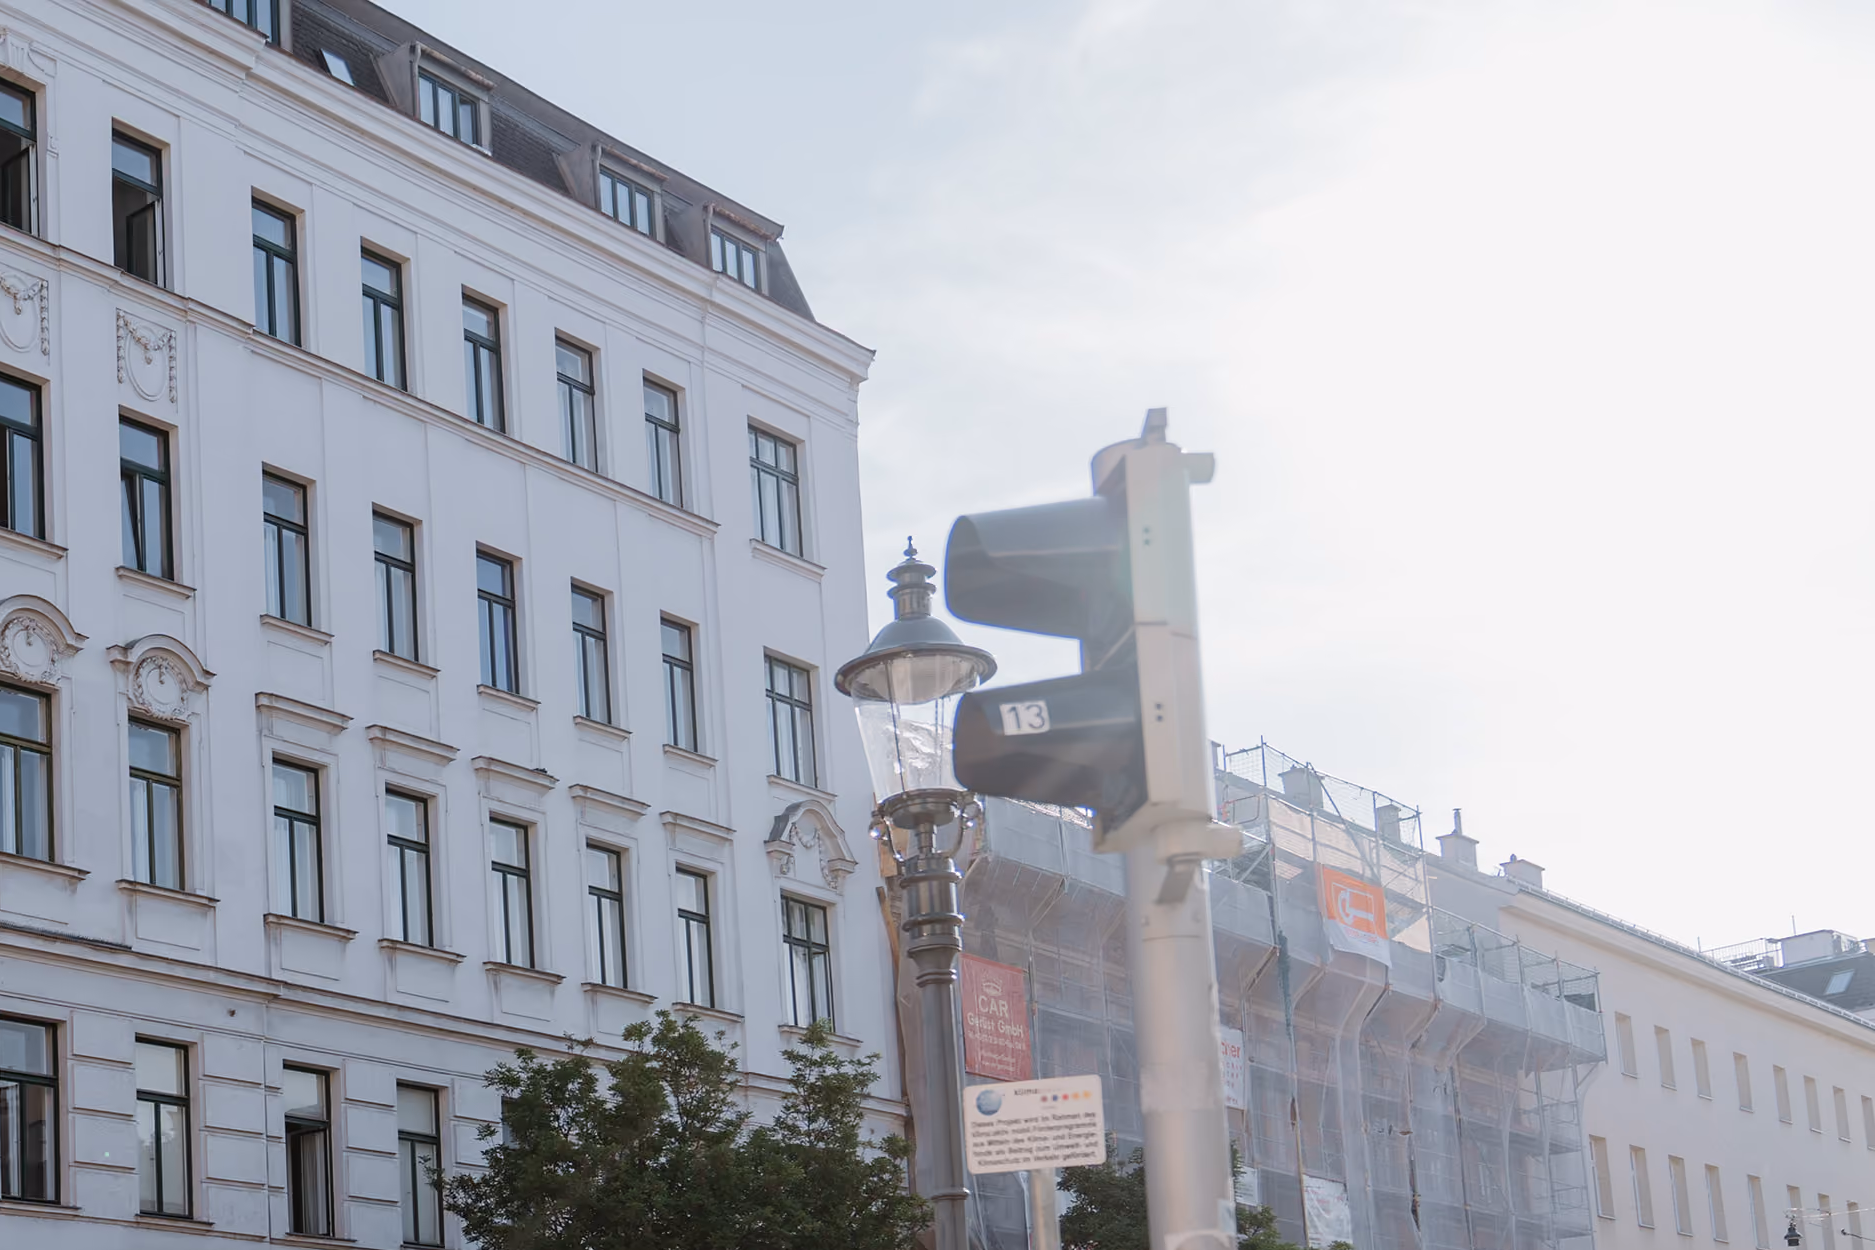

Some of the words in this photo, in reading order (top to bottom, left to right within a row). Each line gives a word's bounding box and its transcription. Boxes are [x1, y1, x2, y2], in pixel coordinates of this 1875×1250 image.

[1007, 704, 1045, 730] 13
[978, 995, 1009, 1019] CAR
[997, 1020, 1024, 1038] GmbH
